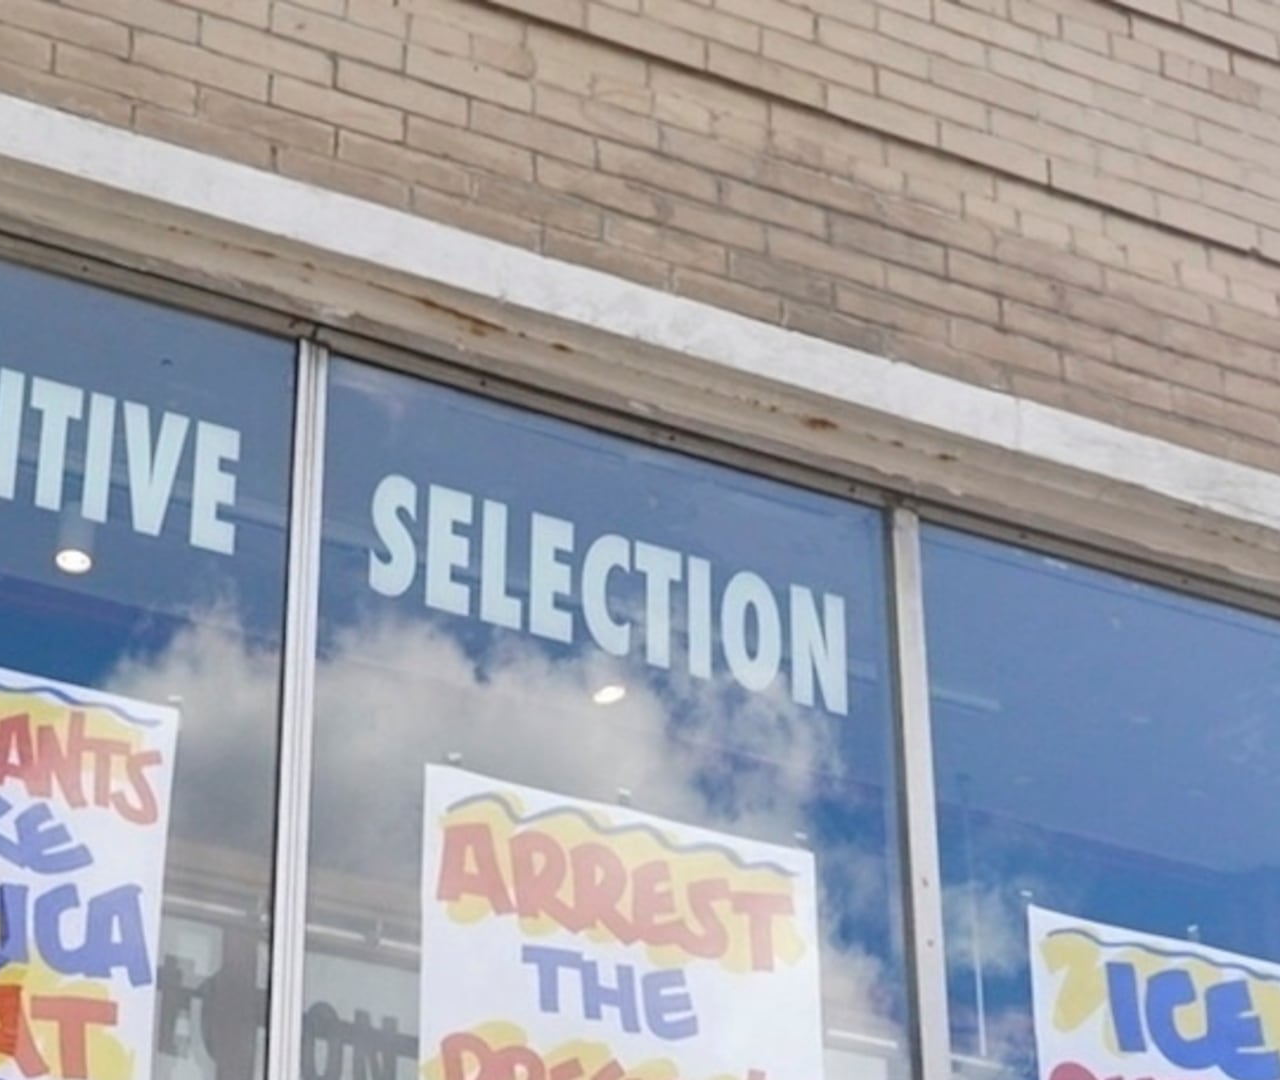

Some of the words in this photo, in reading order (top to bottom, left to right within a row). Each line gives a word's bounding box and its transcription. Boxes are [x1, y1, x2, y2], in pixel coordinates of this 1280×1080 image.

[368, 474, 848, 716] SELECTION
[435, 821, 795, 972] ARREST
[520, 944, 699, 1042] THE
